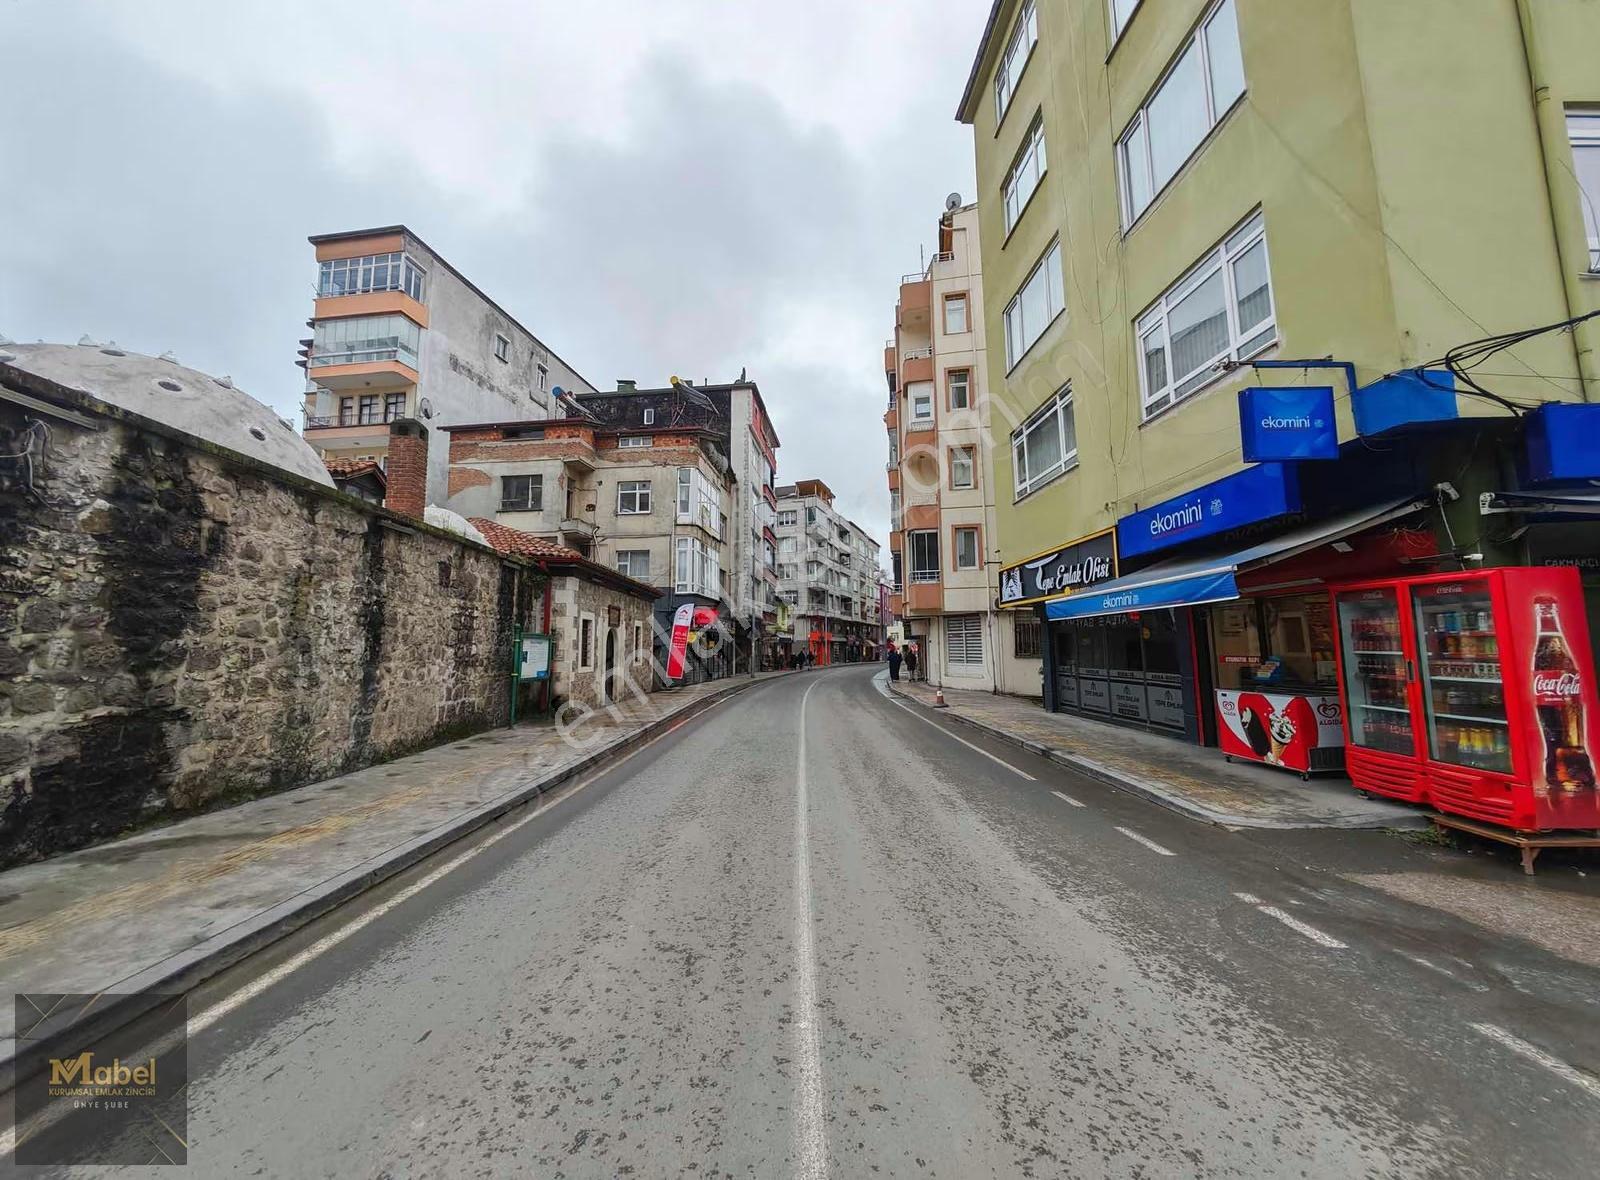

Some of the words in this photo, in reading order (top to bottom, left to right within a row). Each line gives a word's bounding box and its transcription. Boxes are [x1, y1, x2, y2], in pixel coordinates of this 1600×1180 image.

[1261, 416, 1310, 429] ekomini
[1150, 499, 1202, 535] ekomini
[1024, 553, 1060, 595] Tepe
[1056, 564, 1082, 590] Emlak
[1083, 556, 1110, 584] Ofisi
[1103, 592, 1132, 609] ekomini
[1534, 672, 1581, 696] Coca-Cola
